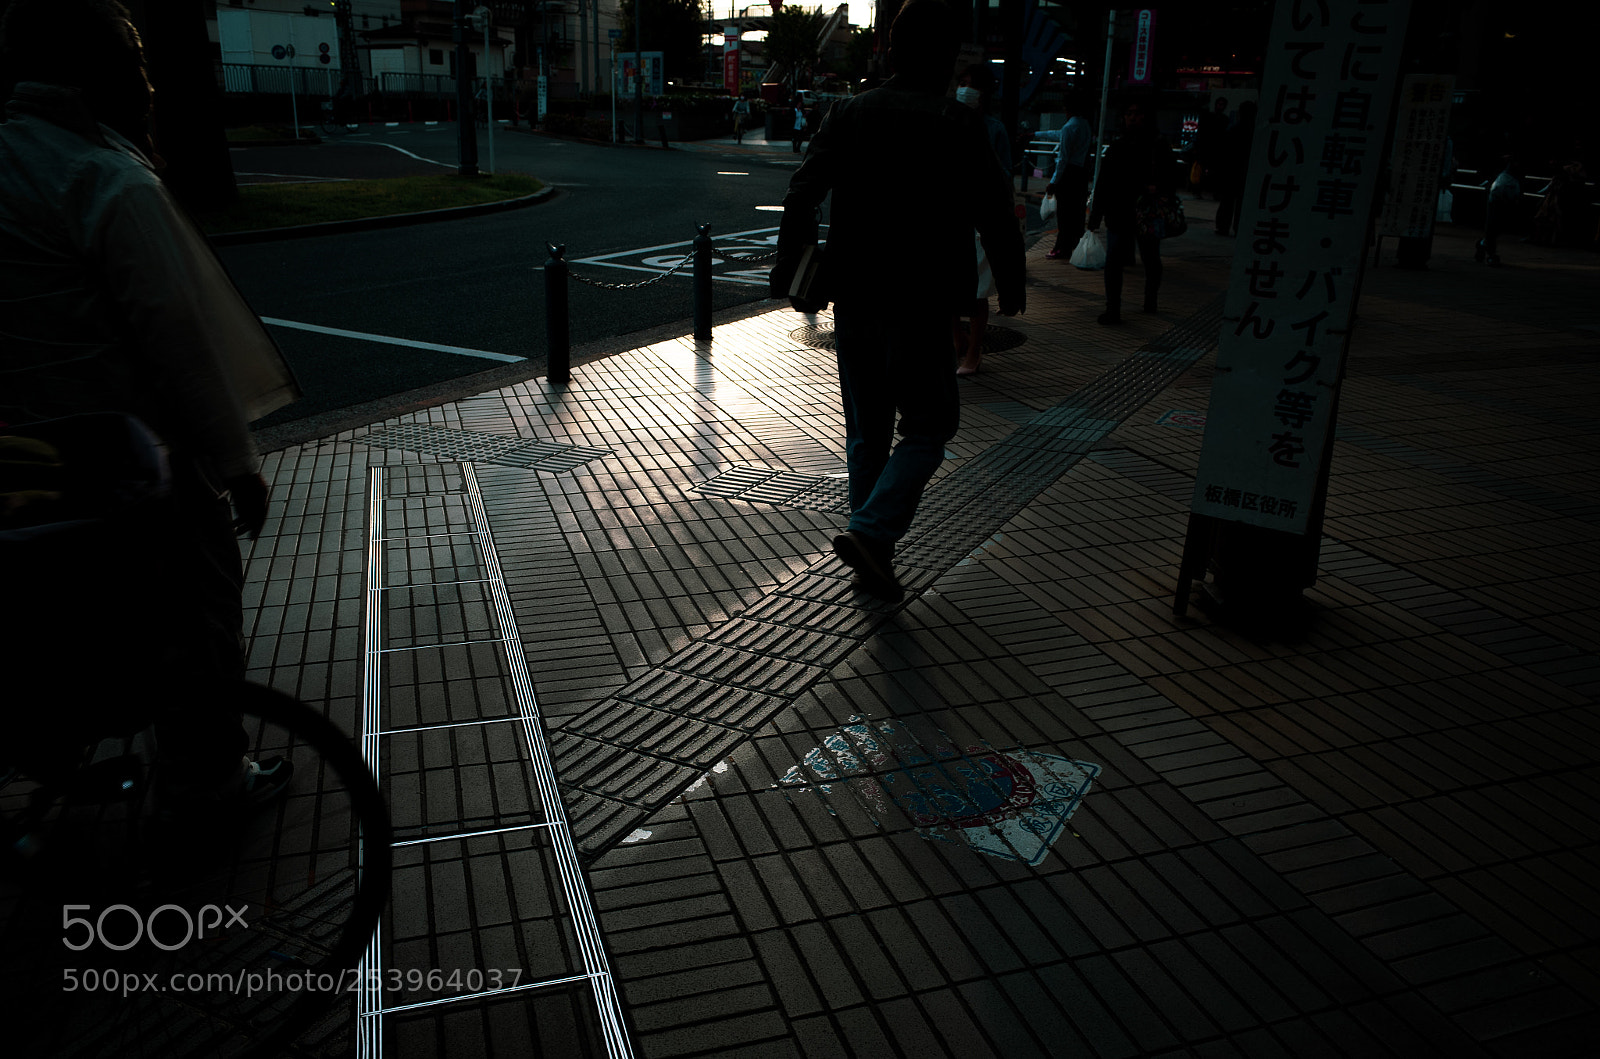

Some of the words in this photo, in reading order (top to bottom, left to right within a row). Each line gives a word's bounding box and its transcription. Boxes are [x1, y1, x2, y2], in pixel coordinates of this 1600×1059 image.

[1204, 484, 1298, 519] 板橋区役所
